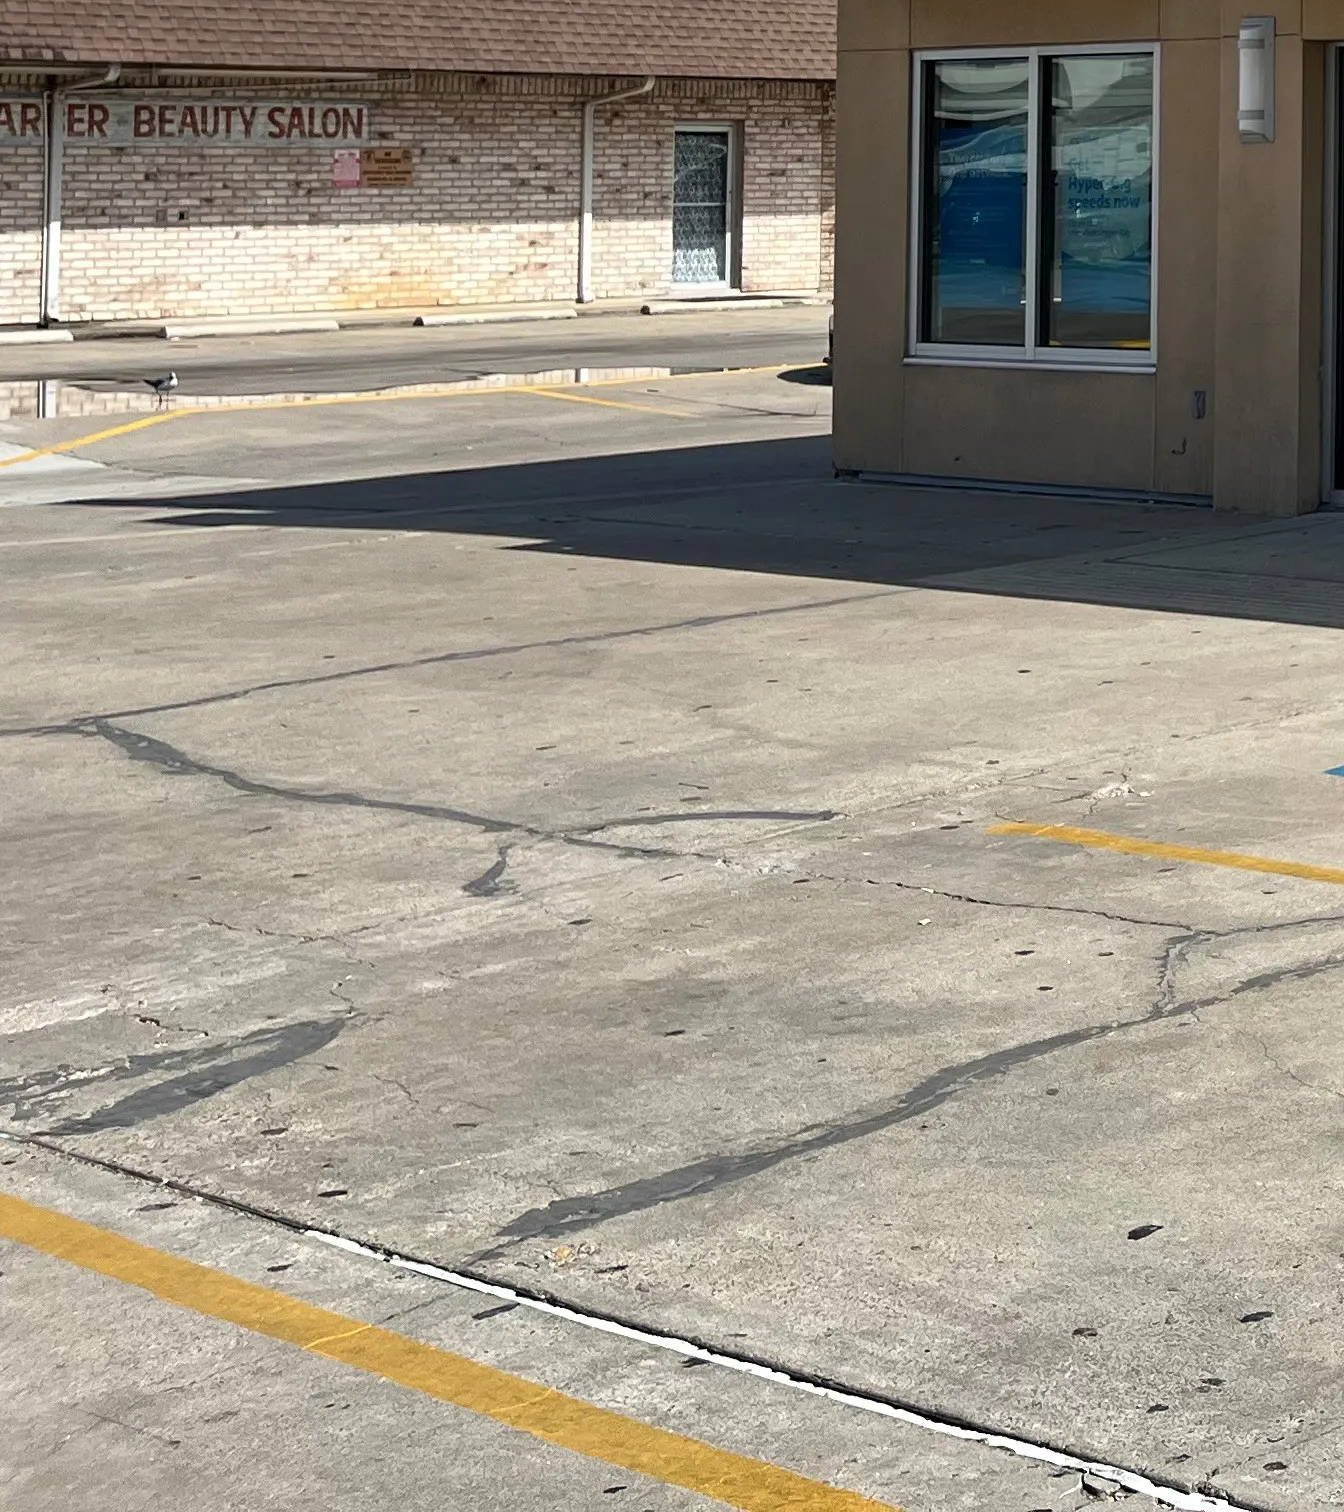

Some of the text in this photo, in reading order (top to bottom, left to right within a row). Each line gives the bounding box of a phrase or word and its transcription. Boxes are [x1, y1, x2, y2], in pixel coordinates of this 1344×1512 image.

[0, 103, 364, 139] ARER BEAUTY SALON
[1113, 197, 1141, 209] now
